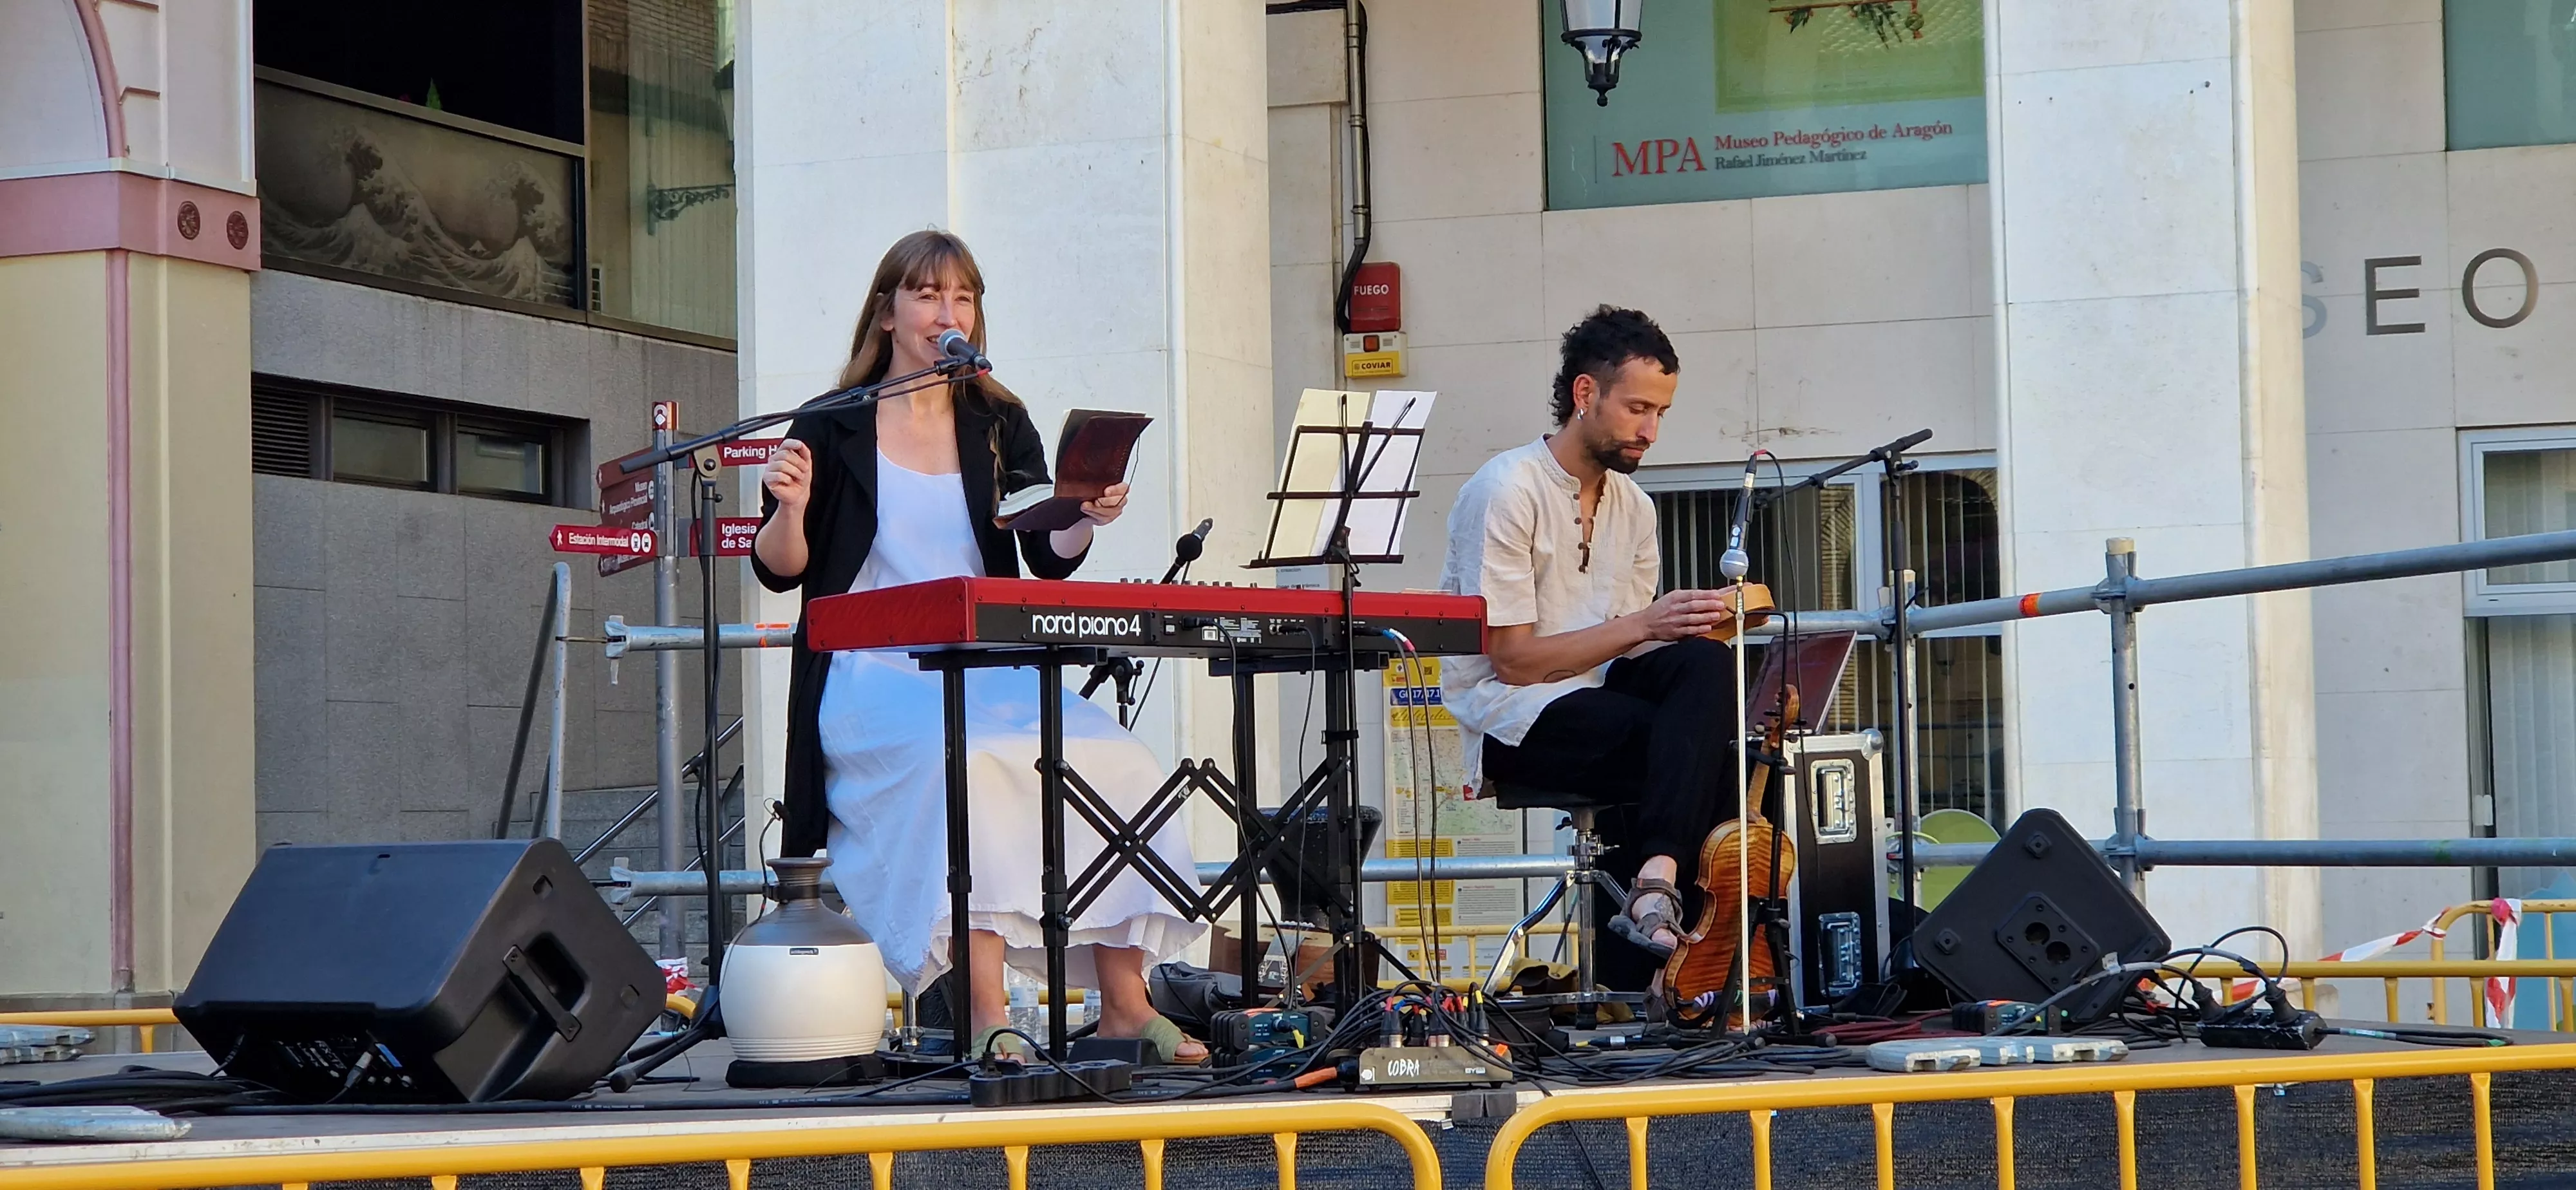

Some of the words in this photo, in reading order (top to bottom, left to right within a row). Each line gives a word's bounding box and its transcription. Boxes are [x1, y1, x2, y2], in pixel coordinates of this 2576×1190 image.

[1714, 134, 1768, 151] Museo
[1773, 128, 1864, 149] Pedagógico
[1868, 124, 1888, 140] de
[1892, 120, 1953, 140] Aragón
[1612, 137, 1708, 177] MPA
[1714, 155, 1753, 170] Rafael
[1755, 152, 1805, 167] Jiménez
[1809, 148, 1867, 164] Martínez
[1354, 284, 1389, 296] FUEGO
[1361, 362, 1391, 370] COVIAR
[724, 446, 766, 459] Parking
[768, 445, 777, 456] H
[722, 522, 757, 536] Iglesia
[569, 533, 596, 545] Estación
[596, 534, 629, 547] Intermodal
[721, 538, 736, 549] de
[738, 537, 752, 549] Sa
[1032, 612, 1075, 634] nord
[1079, 616, 1128, 638] piano
[1399, 689, 1409, 699] G
[1387, 1058, 1420, 1077] COBRA
